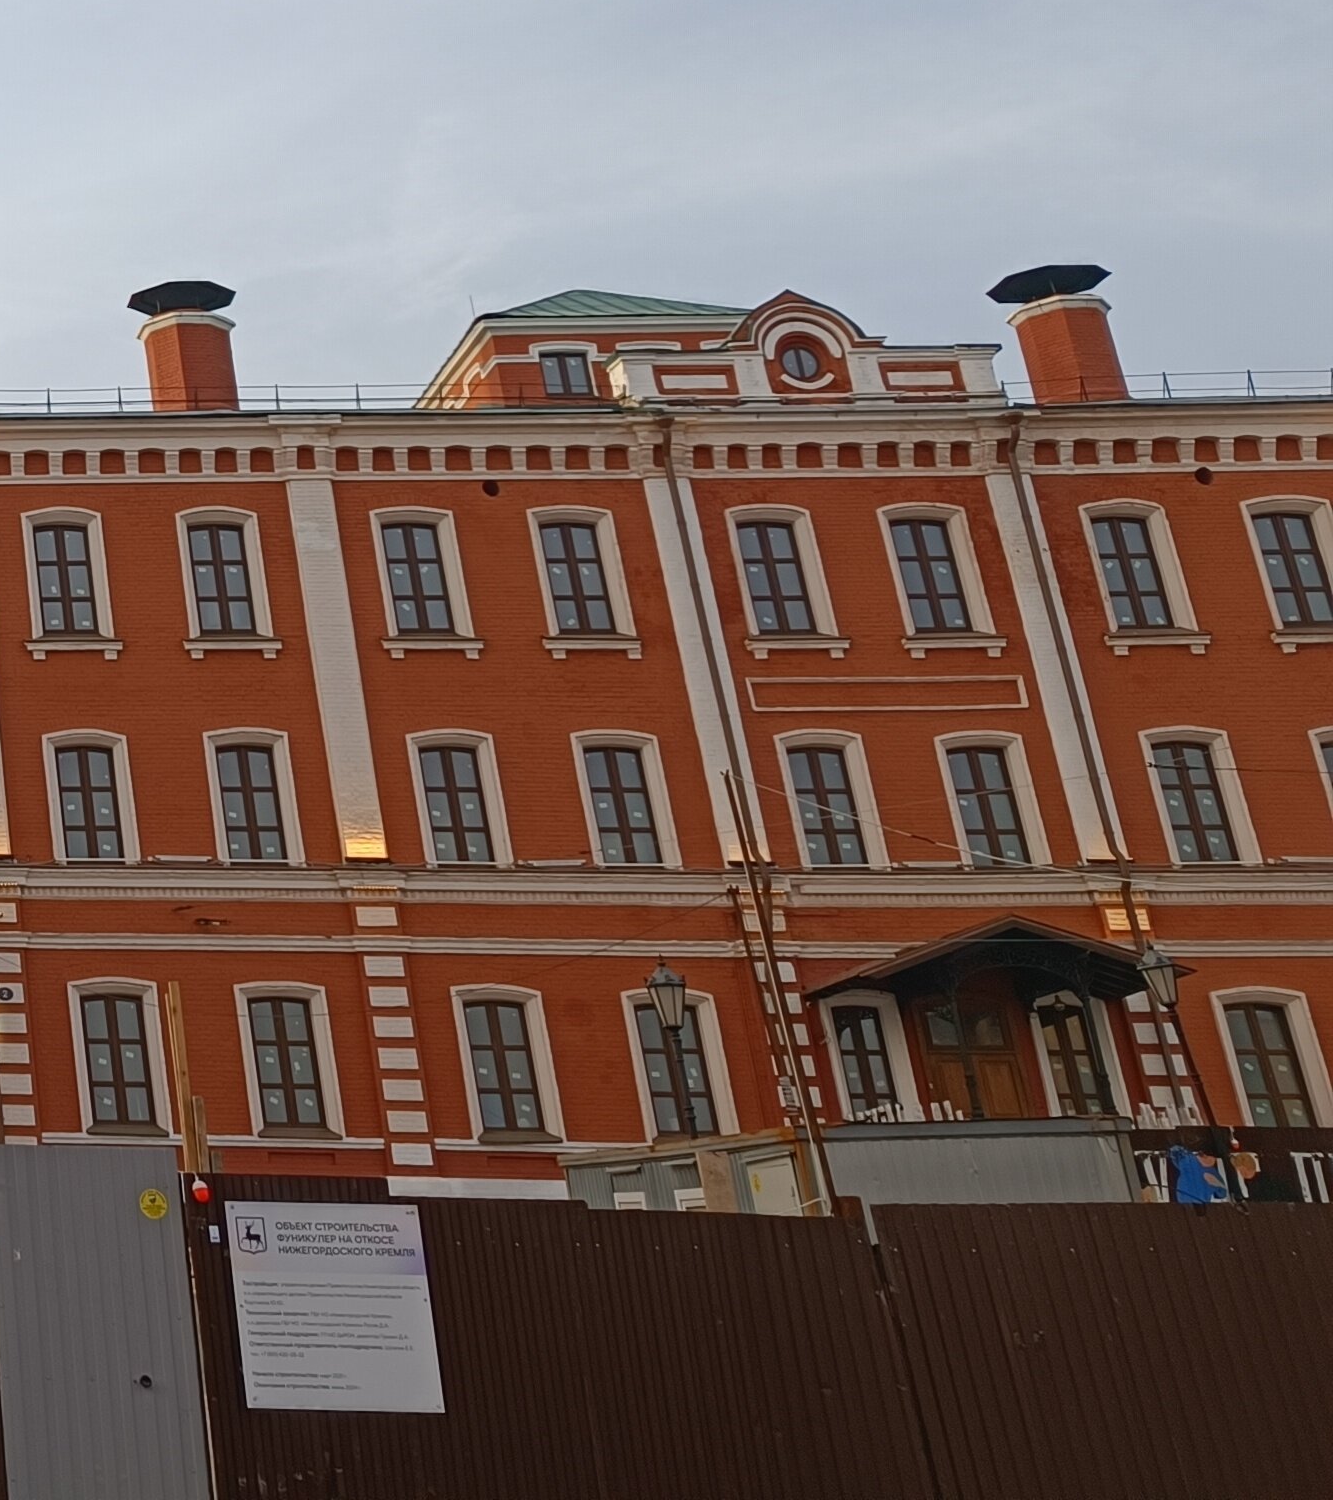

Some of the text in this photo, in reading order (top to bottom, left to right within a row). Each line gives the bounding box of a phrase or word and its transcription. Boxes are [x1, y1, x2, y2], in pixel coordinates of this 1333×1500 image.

[275, 1221, 399, 1232] ОБЪЕКТ СТРОИТЕЛЬСТВА
[276, 1234, 395, 1245] ФУНИКУЛЕР НА ОТКОСЕ
[278, 1246, 416, 1257] НИЖЕГОРДОСКОГО КРЕМЛЯ
